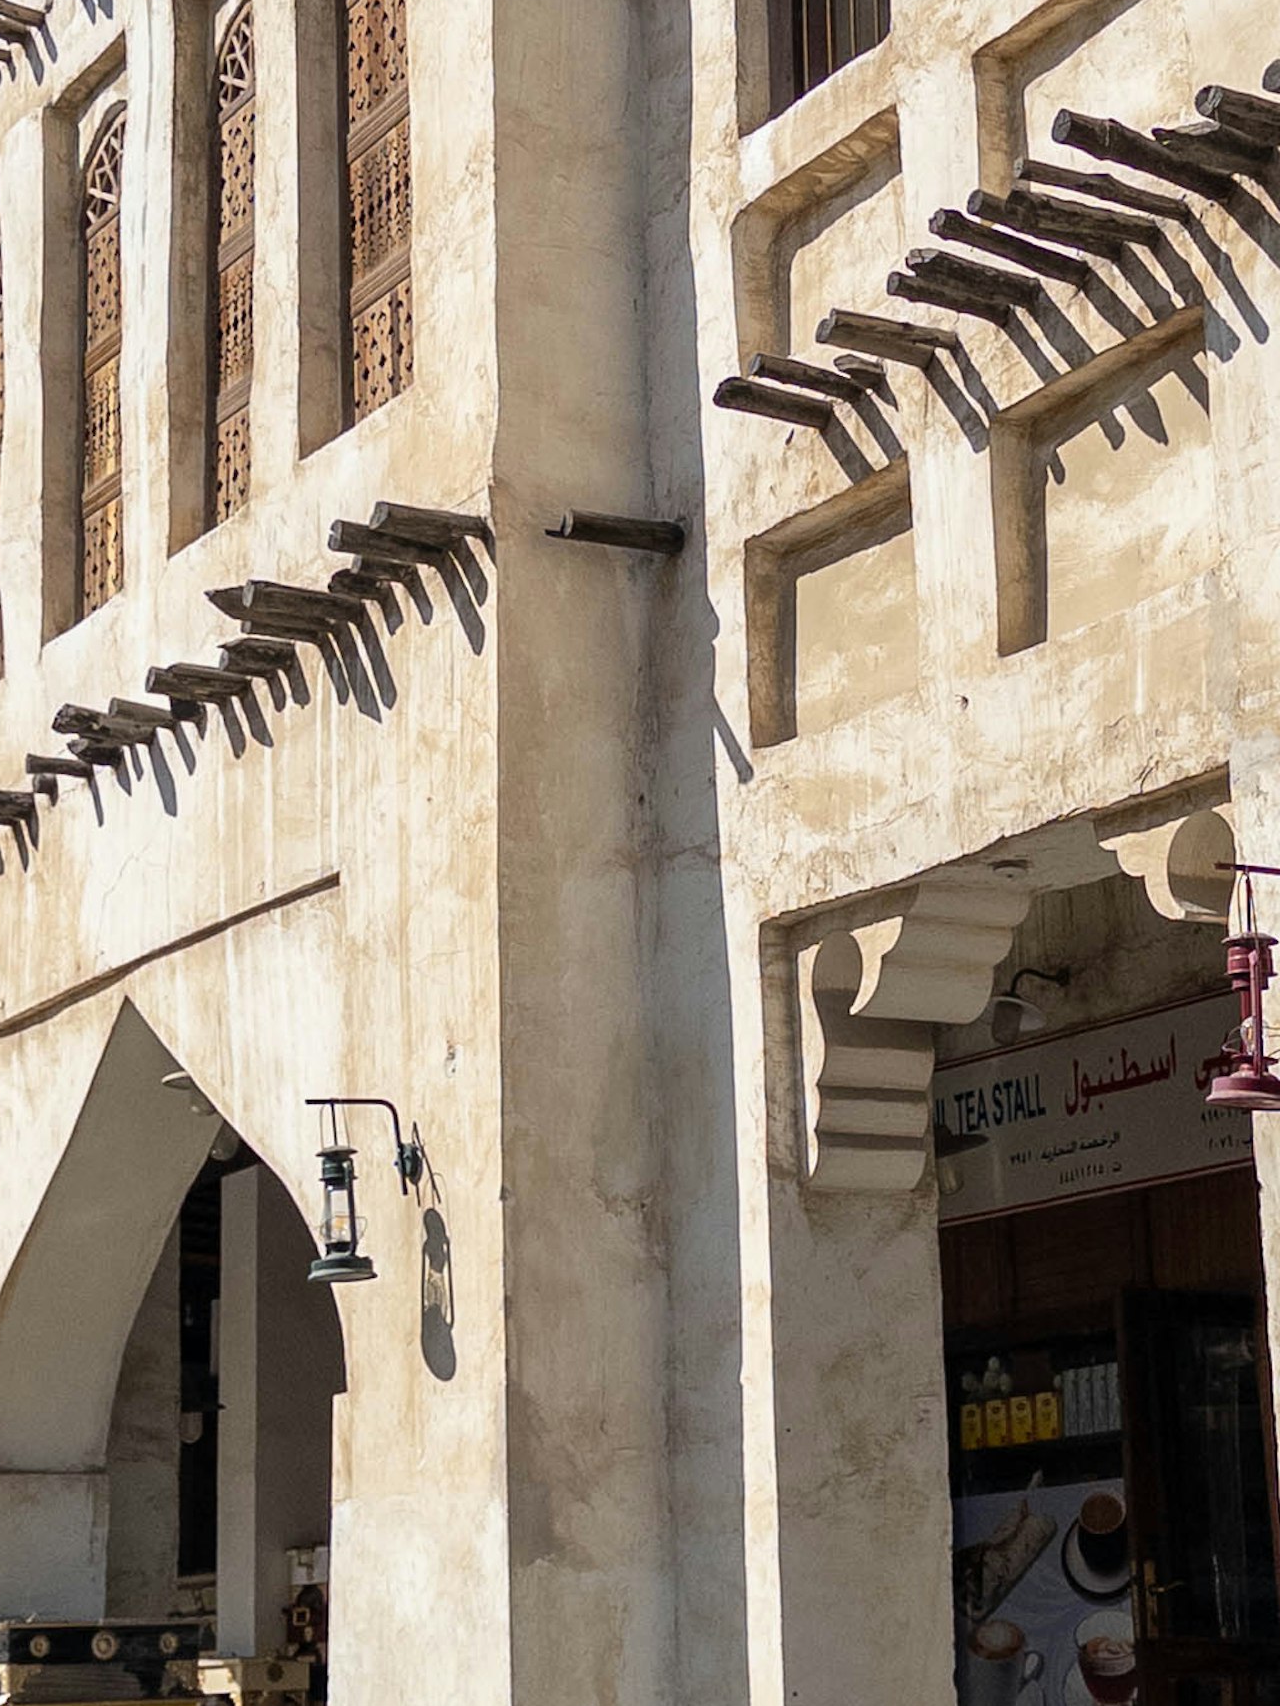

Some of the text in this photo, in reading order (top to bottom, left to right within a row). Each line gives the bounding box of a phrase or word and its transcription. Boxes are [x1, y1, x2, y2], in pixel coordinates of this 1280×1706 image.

[954, 1087, 990, 1136] TEA
[992, 1073, 1047, 1126] STALL
[1065, 1031, 1177, 1117] اسطنبول
